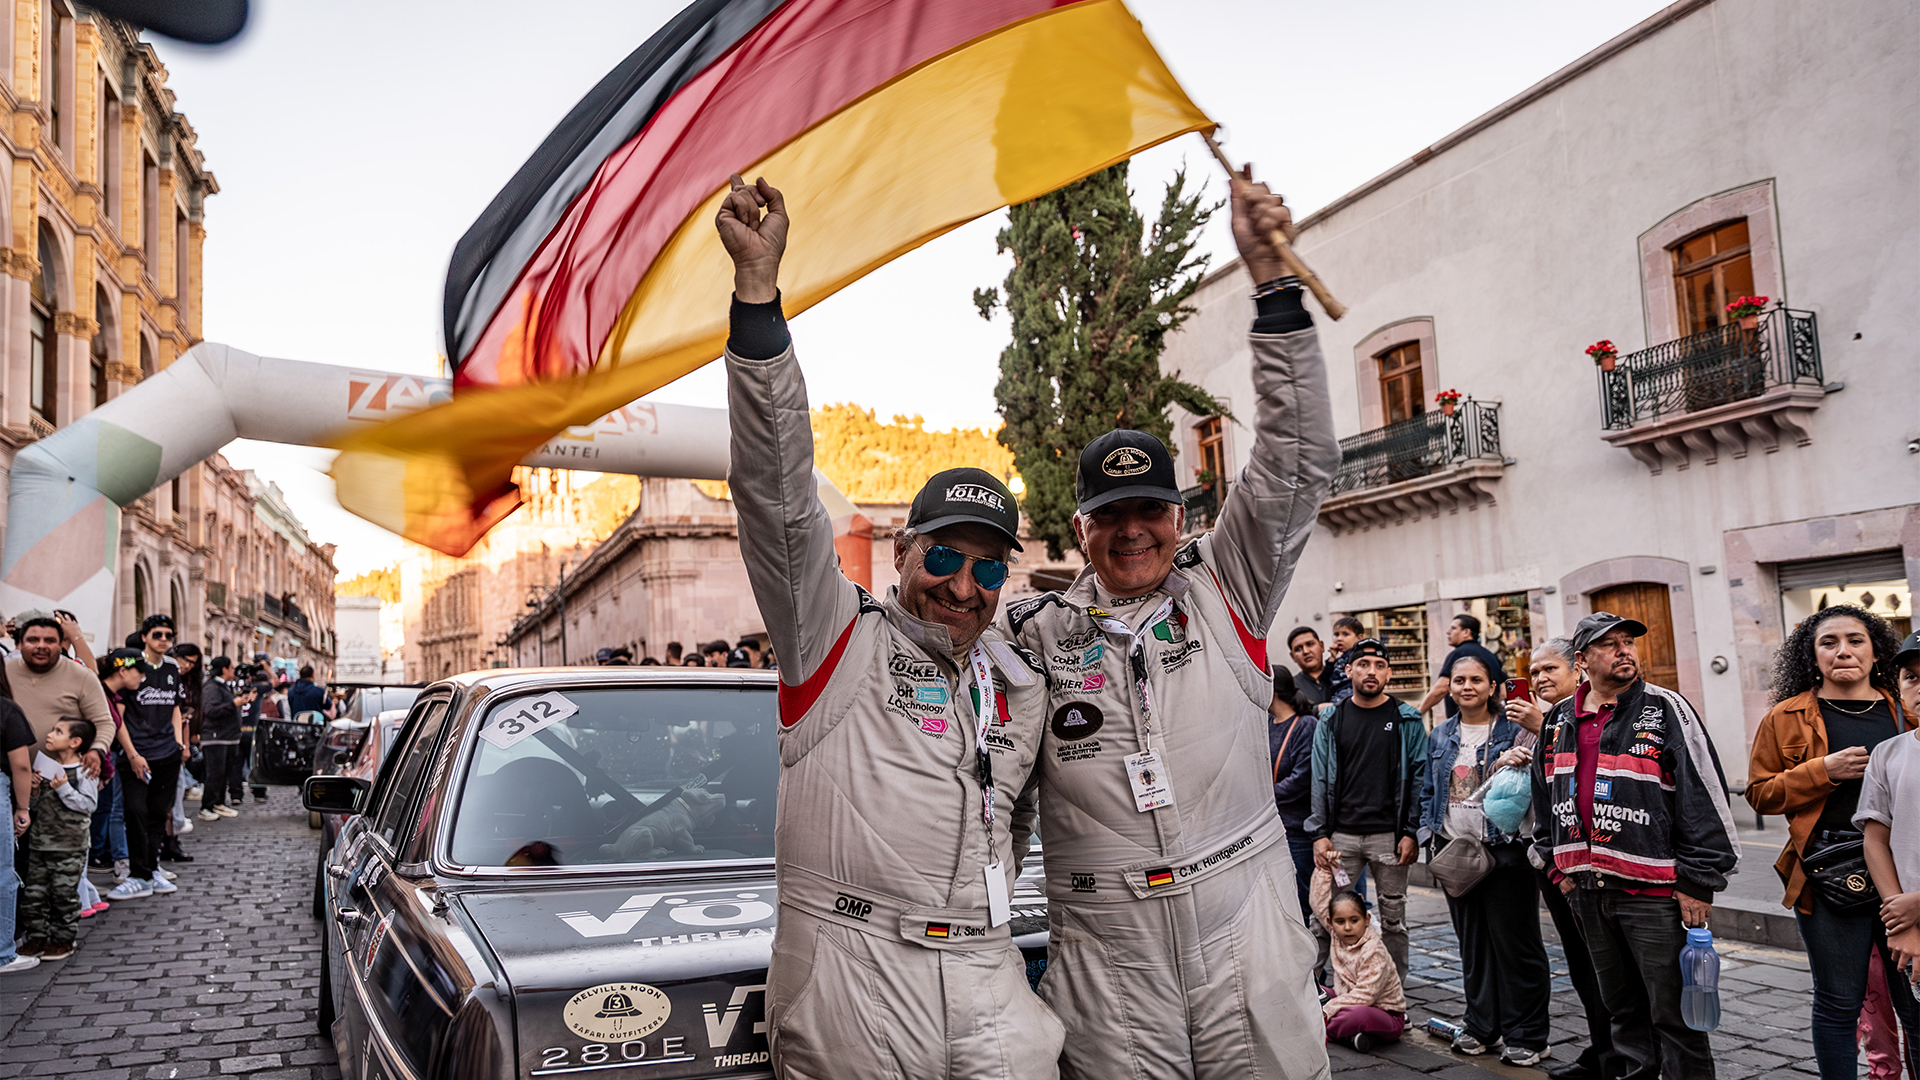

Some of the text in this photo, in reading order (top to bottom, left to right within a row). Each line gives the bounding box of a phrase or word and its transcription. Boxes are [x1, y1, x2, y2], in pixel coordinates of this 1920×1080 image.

[946, 484, 1005, 510] VÖLKEL
[1165, 657, 1192, 674] Germany
[499, 701, 561, 735] 312
[1594, 782, 1609, 793] GM
[1203, 835, 1255, 869] Huntgeburth
[1071, 873, 1097, 892] OMP
[555, 886, 777, 938] VÖ
[834, 893, 872, 920] OMP
[634, 927, 776, 947] THREA
[953, 925, 986, 937] J. Sand
[573, 985, 617, 1005] MELVILL
[630, 985, 661, 999] MOON
[612, 997, 621, 1009] 3
[573, 1016, 663, 1039] SAFARI OUTFITTERS
